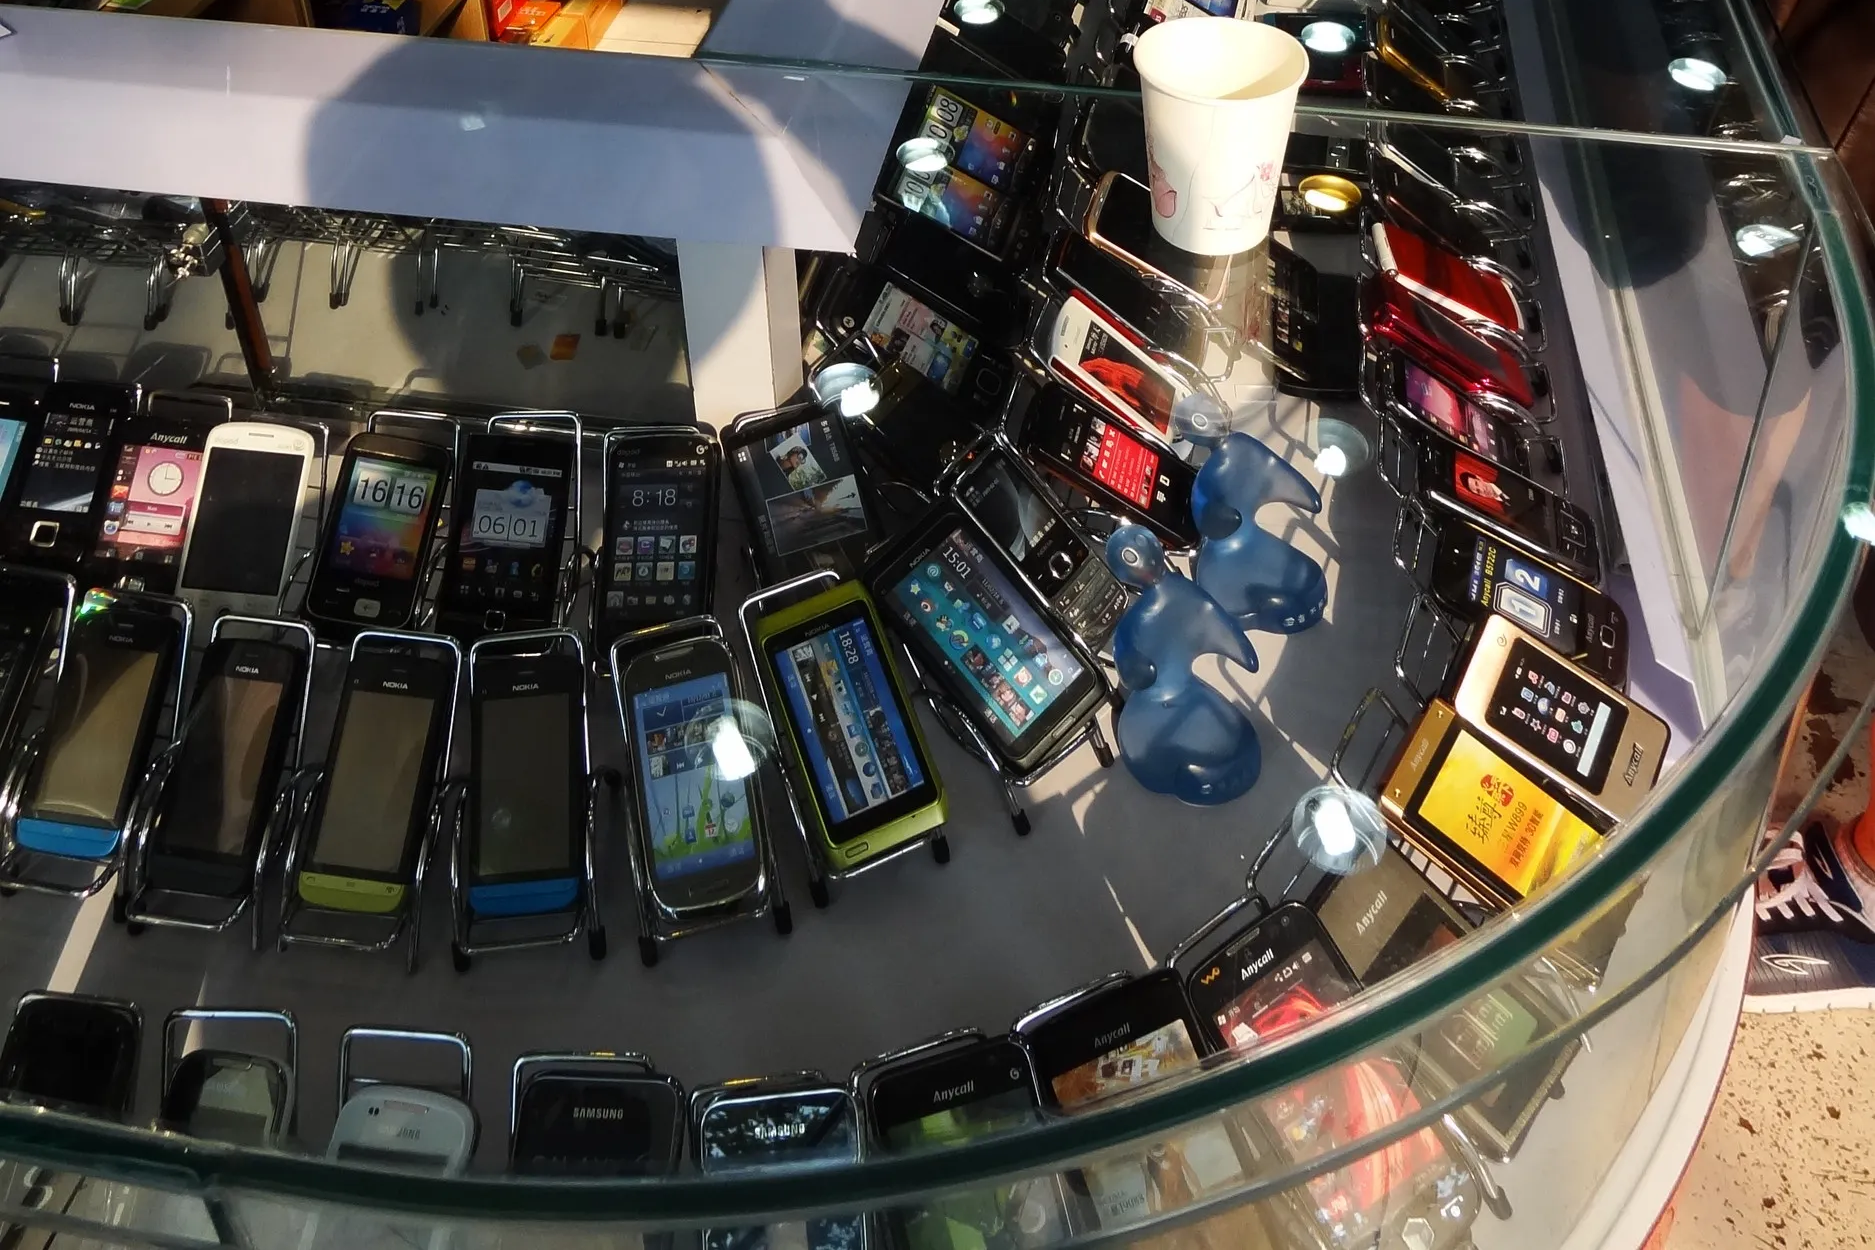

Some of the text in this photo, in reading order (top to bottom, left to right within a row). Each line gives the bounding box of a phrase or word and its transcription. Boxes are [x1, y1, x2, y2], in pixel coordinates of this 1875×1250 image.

[68, 401, 96, 411] NOKIA
[150, 431, 189, 445] Anycall
[359, 476, 425, 510] 16 16
[631, 488, 677, 508] 8:18
[478, 514, 538, 538] 06 01
[908, 547, 932, 569] NOKIA
[942, 546, 972, 580] 15:01
[1514, 568, 1541, 592] 2
[1480, 578, 1493, 608] Anycall
[108, 634, 134, 645] NOKIA
[803, 622, 830, 637] NOKIA
[1584, 612, 1596, 644] Anycall
[838, 630, 860, 665] 18:28
[235, 664, 260, 675] NOKIA
[664, 668, 692, 680] NOKIA
[382, 680, 409, 690] NOKIA
[512, 682, 540, 693] NOKIA
[1409, 736, 1430, 772] Anycall
[1623, 742, 1644, 787] Anycall
[1354, 889, 1389, 936] Anycall
[1239, 947, 1275, 981] Anycall
[1093, 1021, 1132, 1050] Anycall
[932, 1079, 976, 1104] Anycall
[572, 1106, 625, 1121] SAMSUNG
[753, 1123, 806, 1140] SAMSUNG
